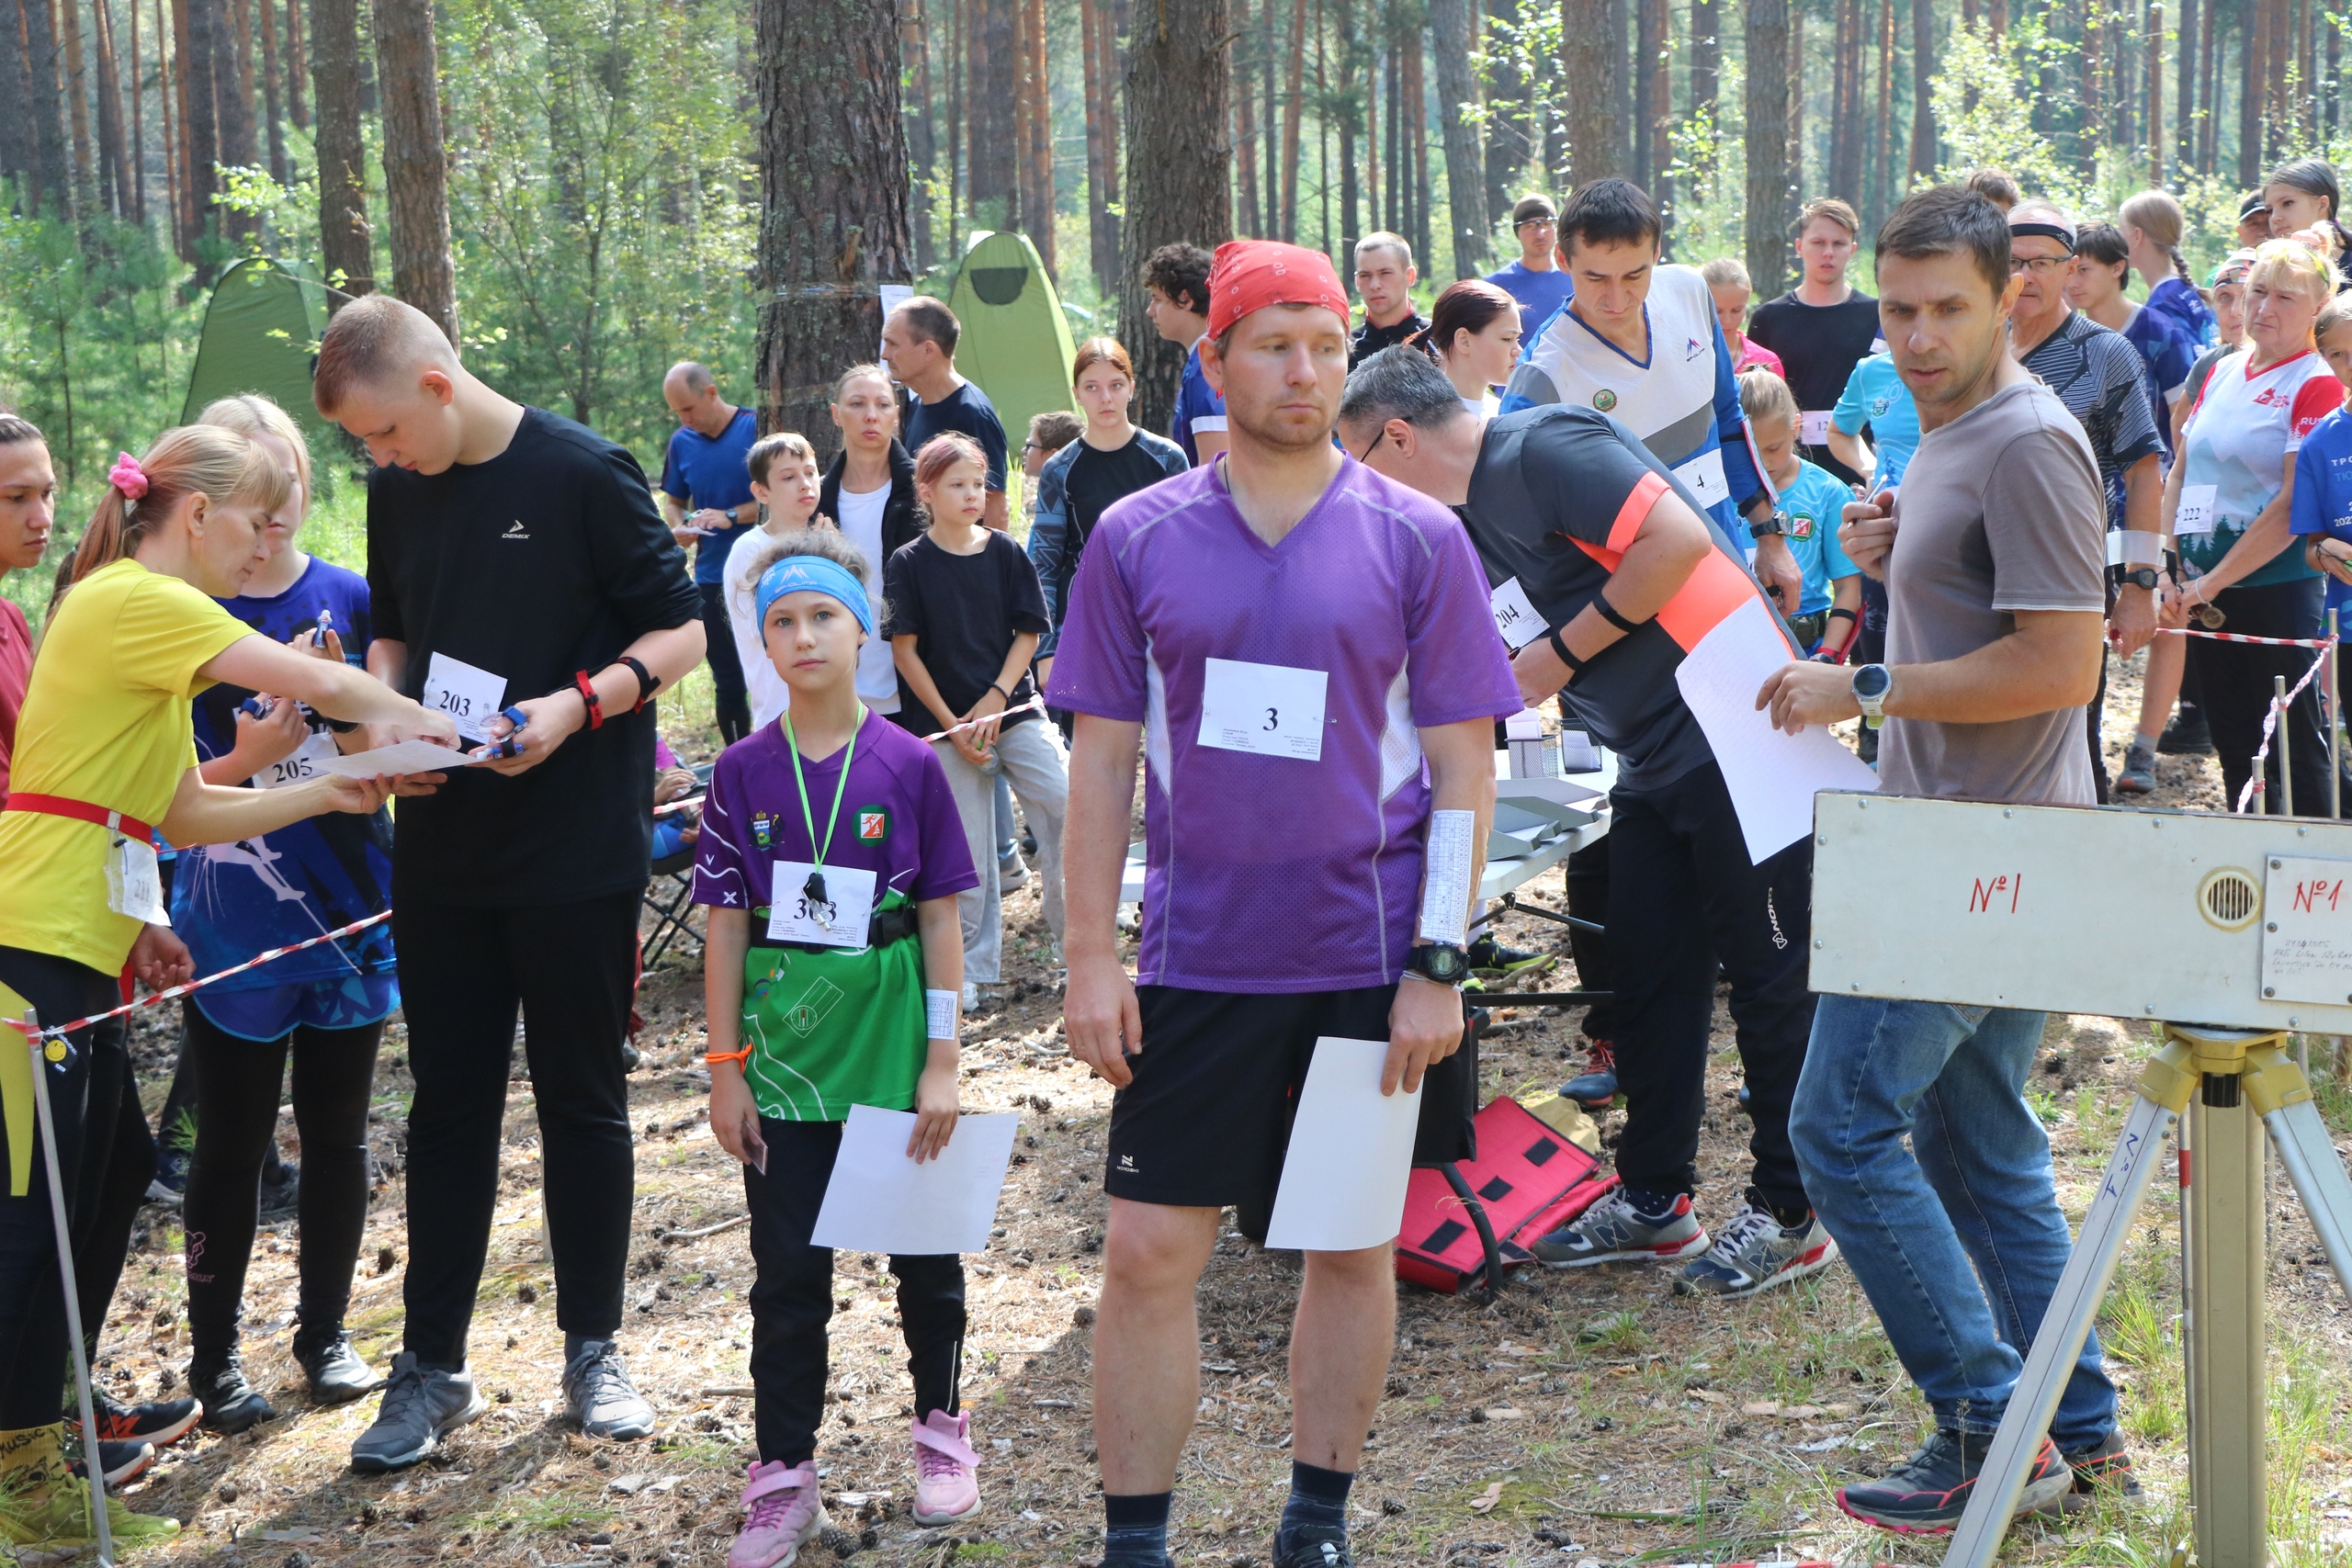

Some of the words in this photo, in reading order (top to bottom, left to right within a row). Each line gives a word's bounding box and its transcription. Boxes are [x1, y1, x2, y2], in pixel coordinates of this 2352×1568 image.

[1697, 474, 1705, 488] 4
[2183, 507, 2200, 522] 222
[1495, 604, 1520, 629] 204
[439, 690, 471, 716] 203
[1262, 707, 1278, 731] 3
[272, 757, 313, 783] 205
